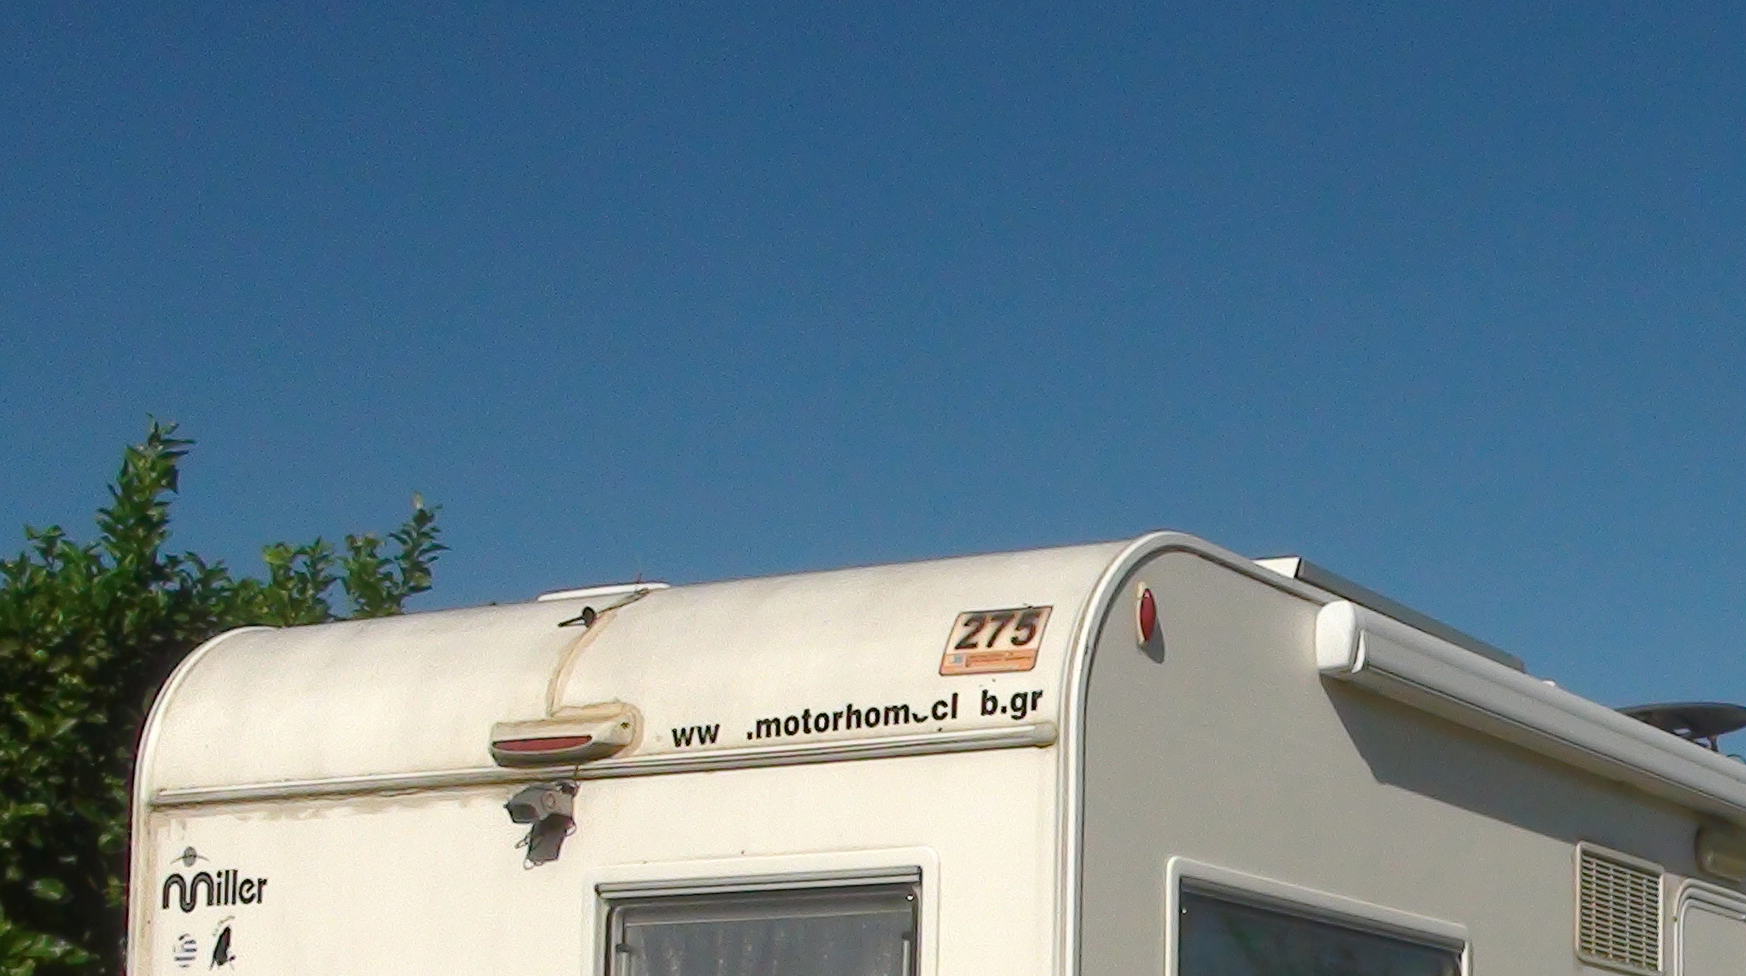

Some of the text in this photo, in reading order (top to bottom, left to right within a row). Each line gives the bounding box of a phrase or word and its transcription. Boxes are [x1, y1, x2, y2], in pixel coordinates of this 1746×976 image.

[954, 609, 1043, 650] 275
[671, 688, 1044, 748] ww.motorhomclb.gr
[162, 869, 268, 913] Miller
